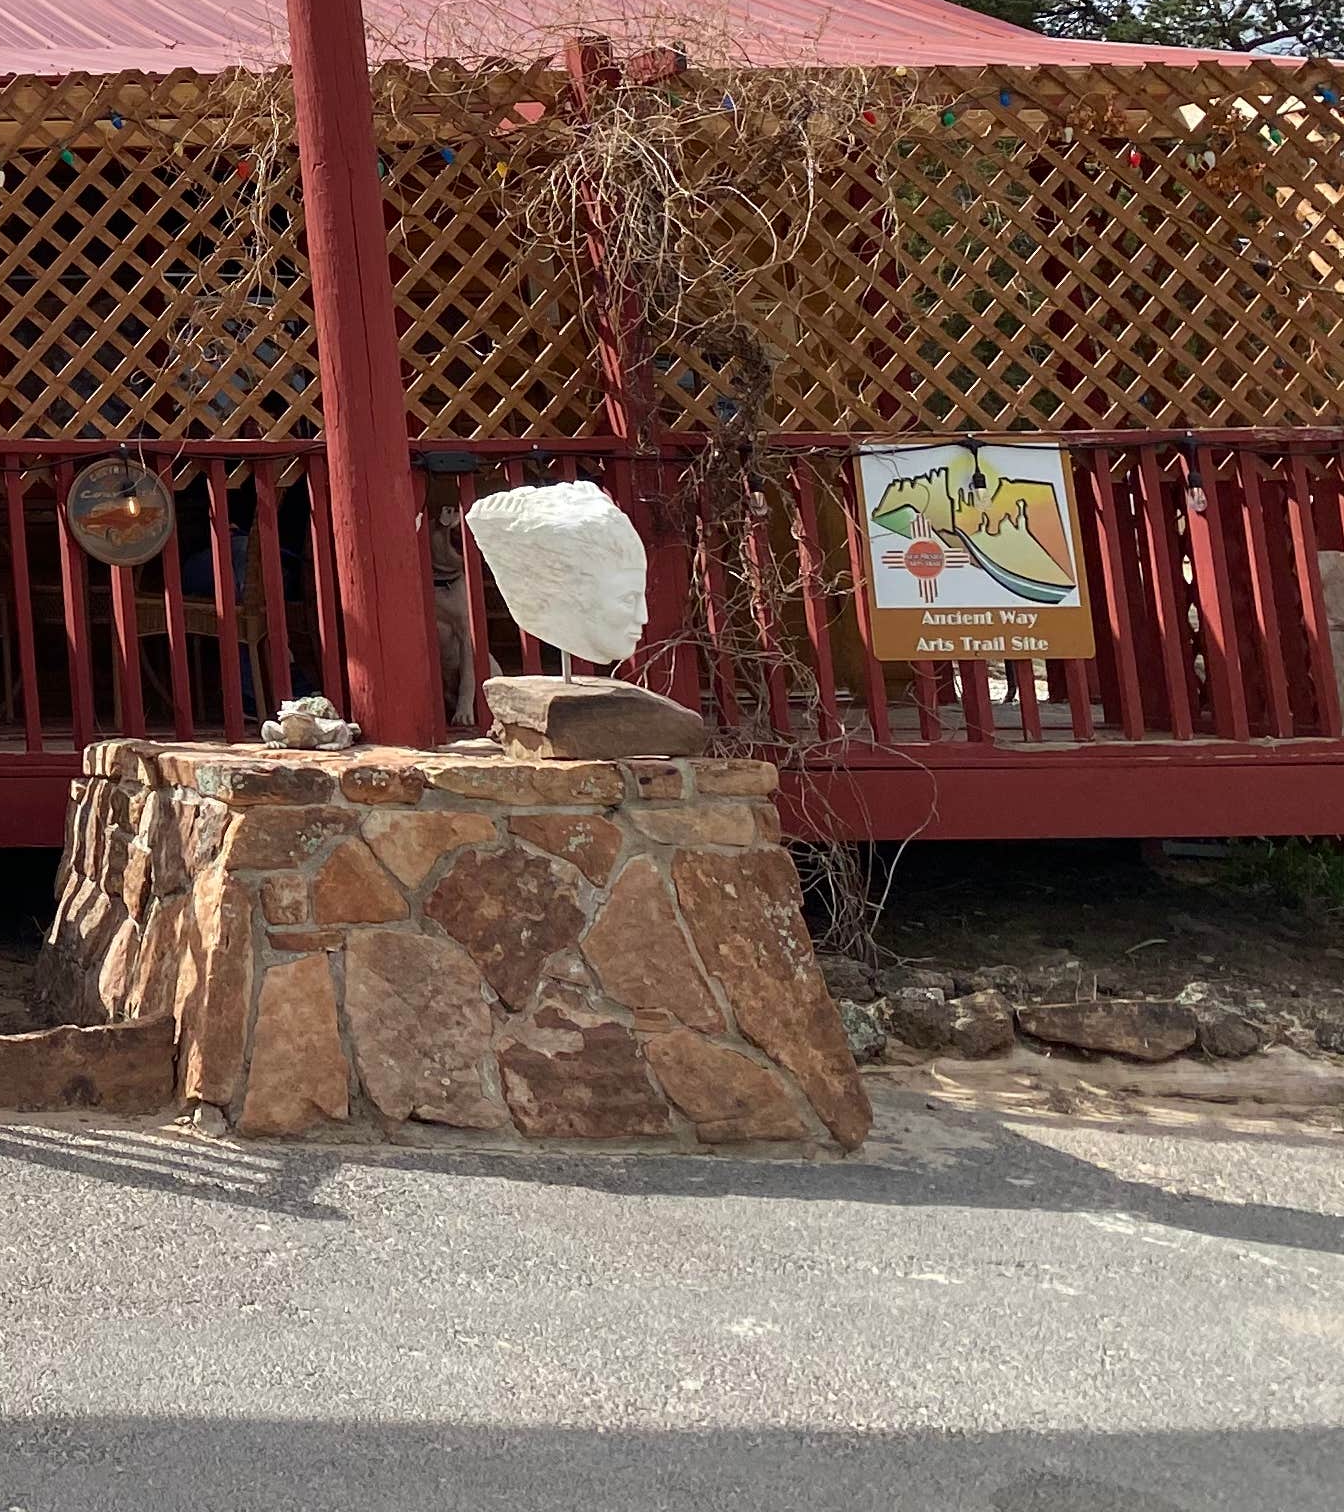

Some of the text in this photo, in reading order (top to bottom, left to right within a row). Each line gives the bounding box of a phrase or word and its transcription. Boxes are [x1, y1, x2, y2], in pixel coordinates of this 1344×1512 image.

[921, 609, 1039, 629] Ancient Way
[916, 635, 1050, 652] Arts Trail Site
